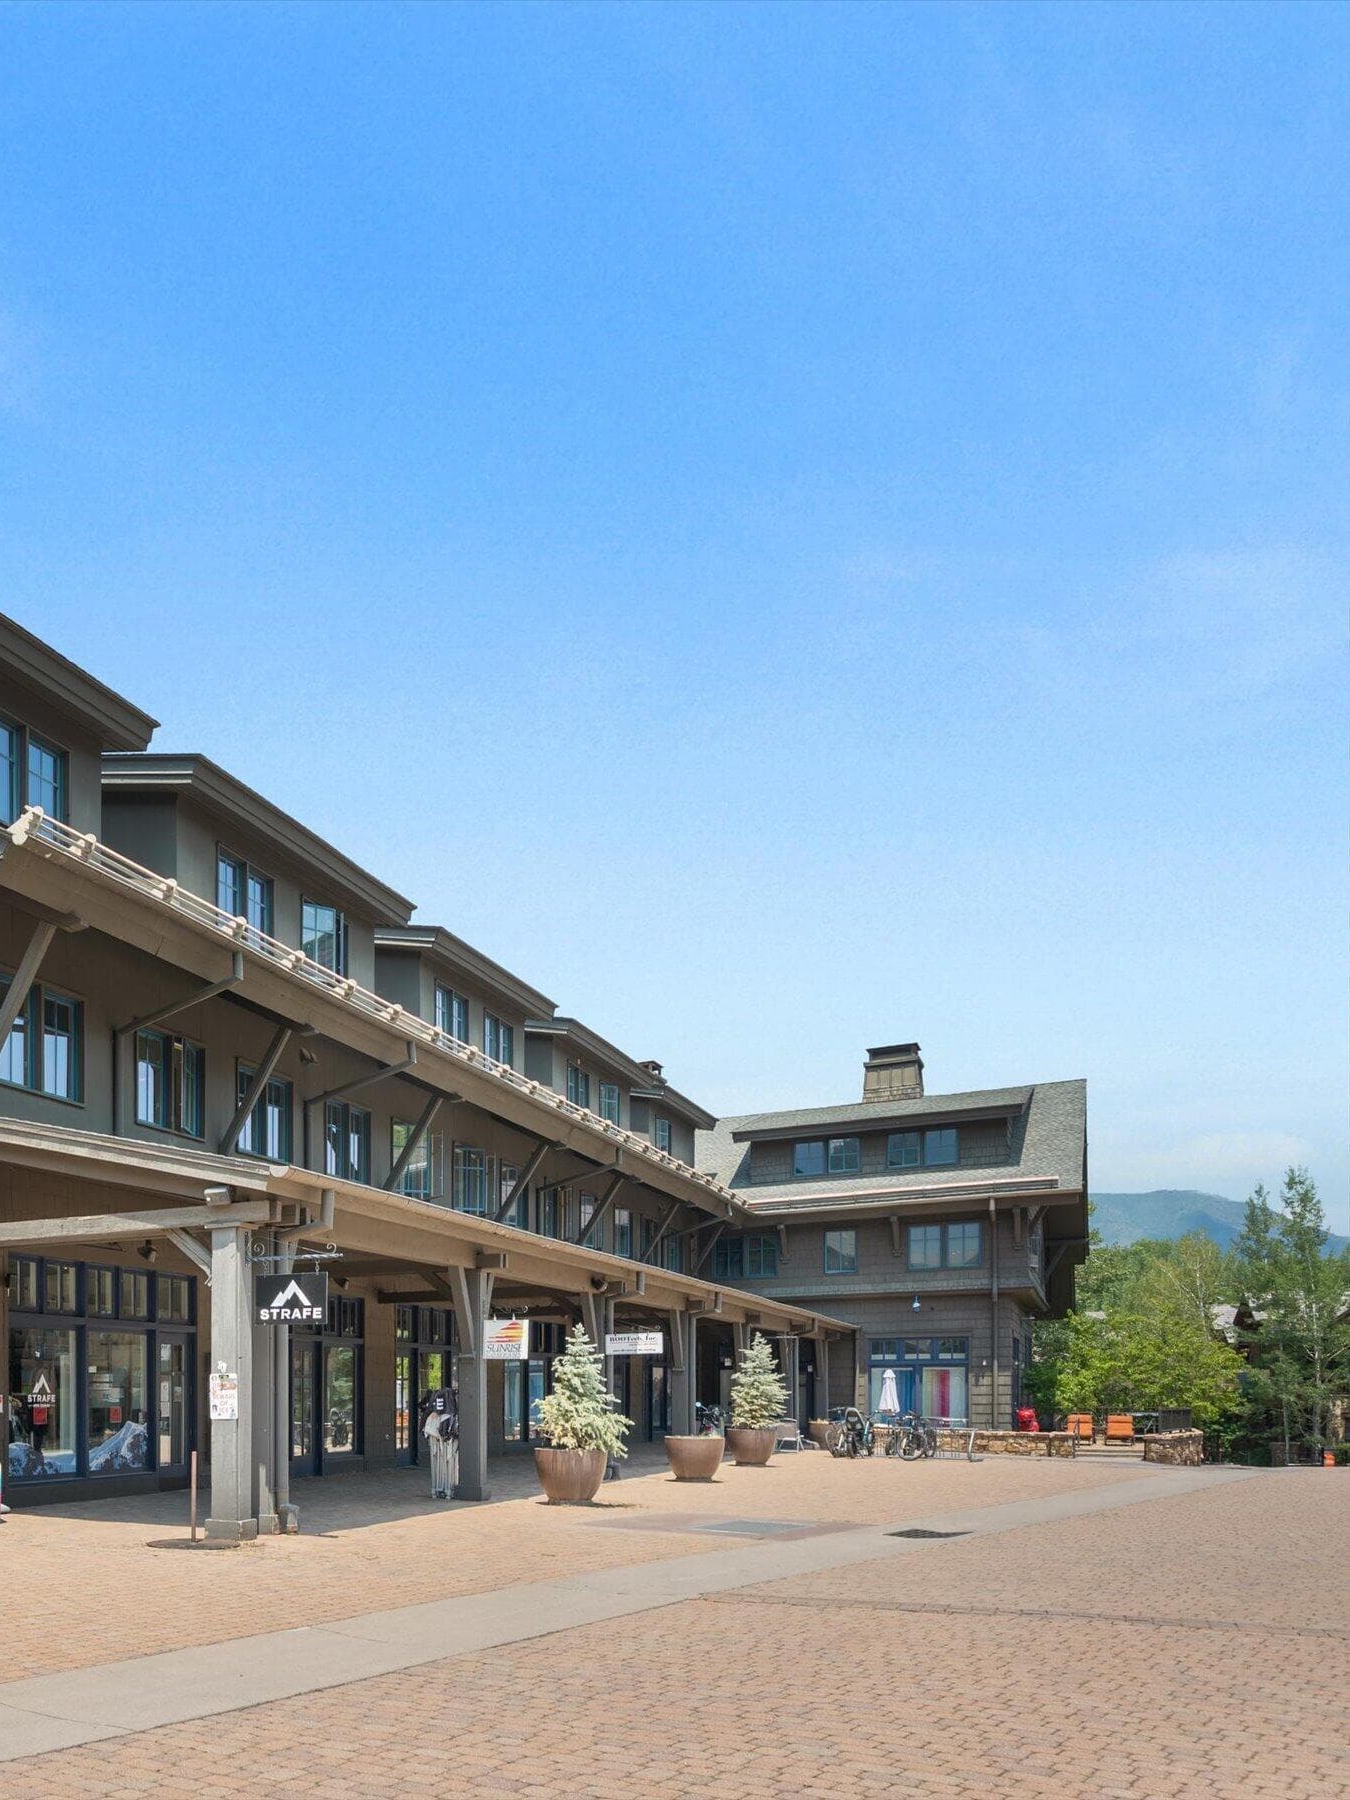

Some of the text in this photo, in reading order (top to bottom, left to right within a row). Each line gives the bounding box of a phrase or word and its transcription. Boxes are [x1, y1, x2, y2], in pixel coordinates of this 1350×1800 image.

[259, 1307, 323, 1321] STRAFE
[487, 1343, 523, 1353] SUNRISE
[27, 1394, 56, 1403] STRAFE
